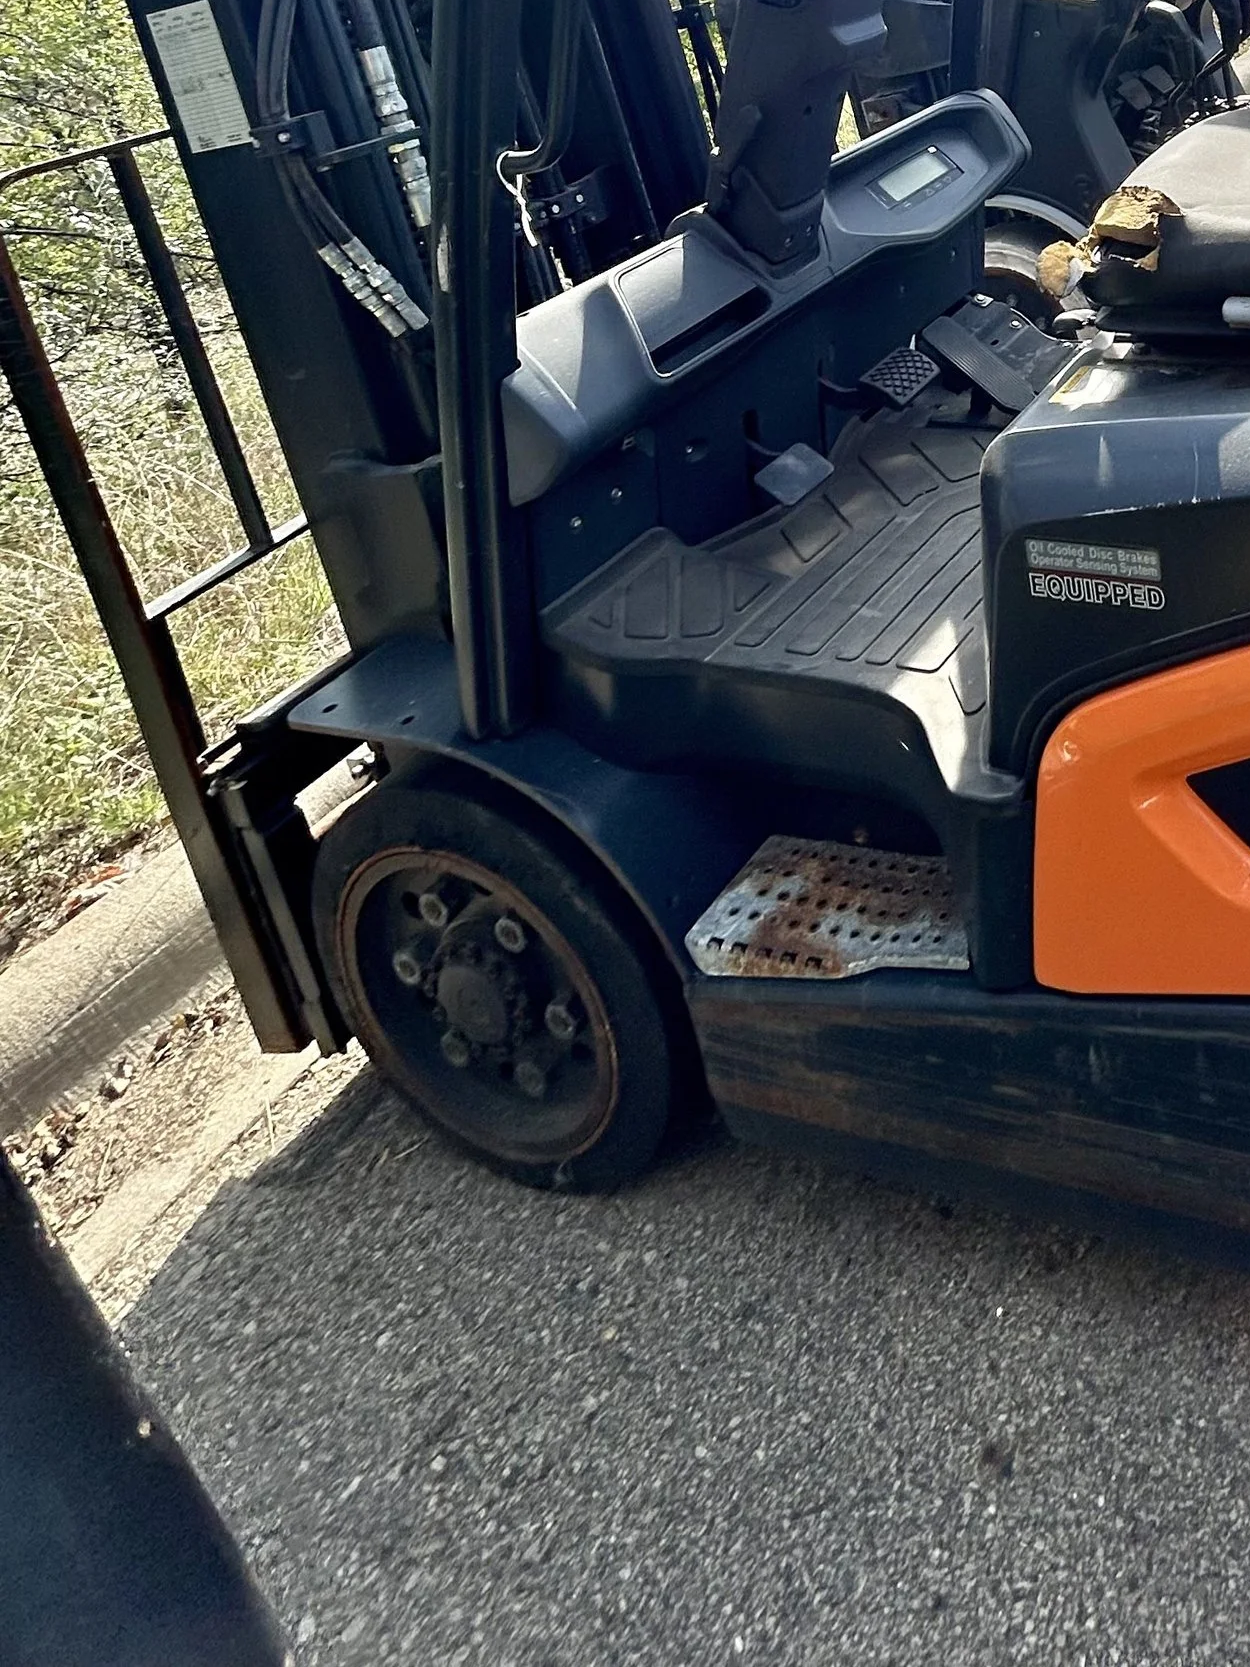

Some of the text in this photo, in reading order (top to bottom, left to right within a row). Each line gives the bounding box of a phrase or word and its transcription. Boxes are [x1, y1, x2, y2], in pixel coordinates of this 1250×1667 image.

[1031, 553, 1158, 577] Operator Sensing System
[1047, 543, 1084, 557] Cooled
[1089, 547, 1113, 560] Disc
[1117, 550, 1158, 565] Brakes
[1028, 572, 1166, 610] EQUIPPED
